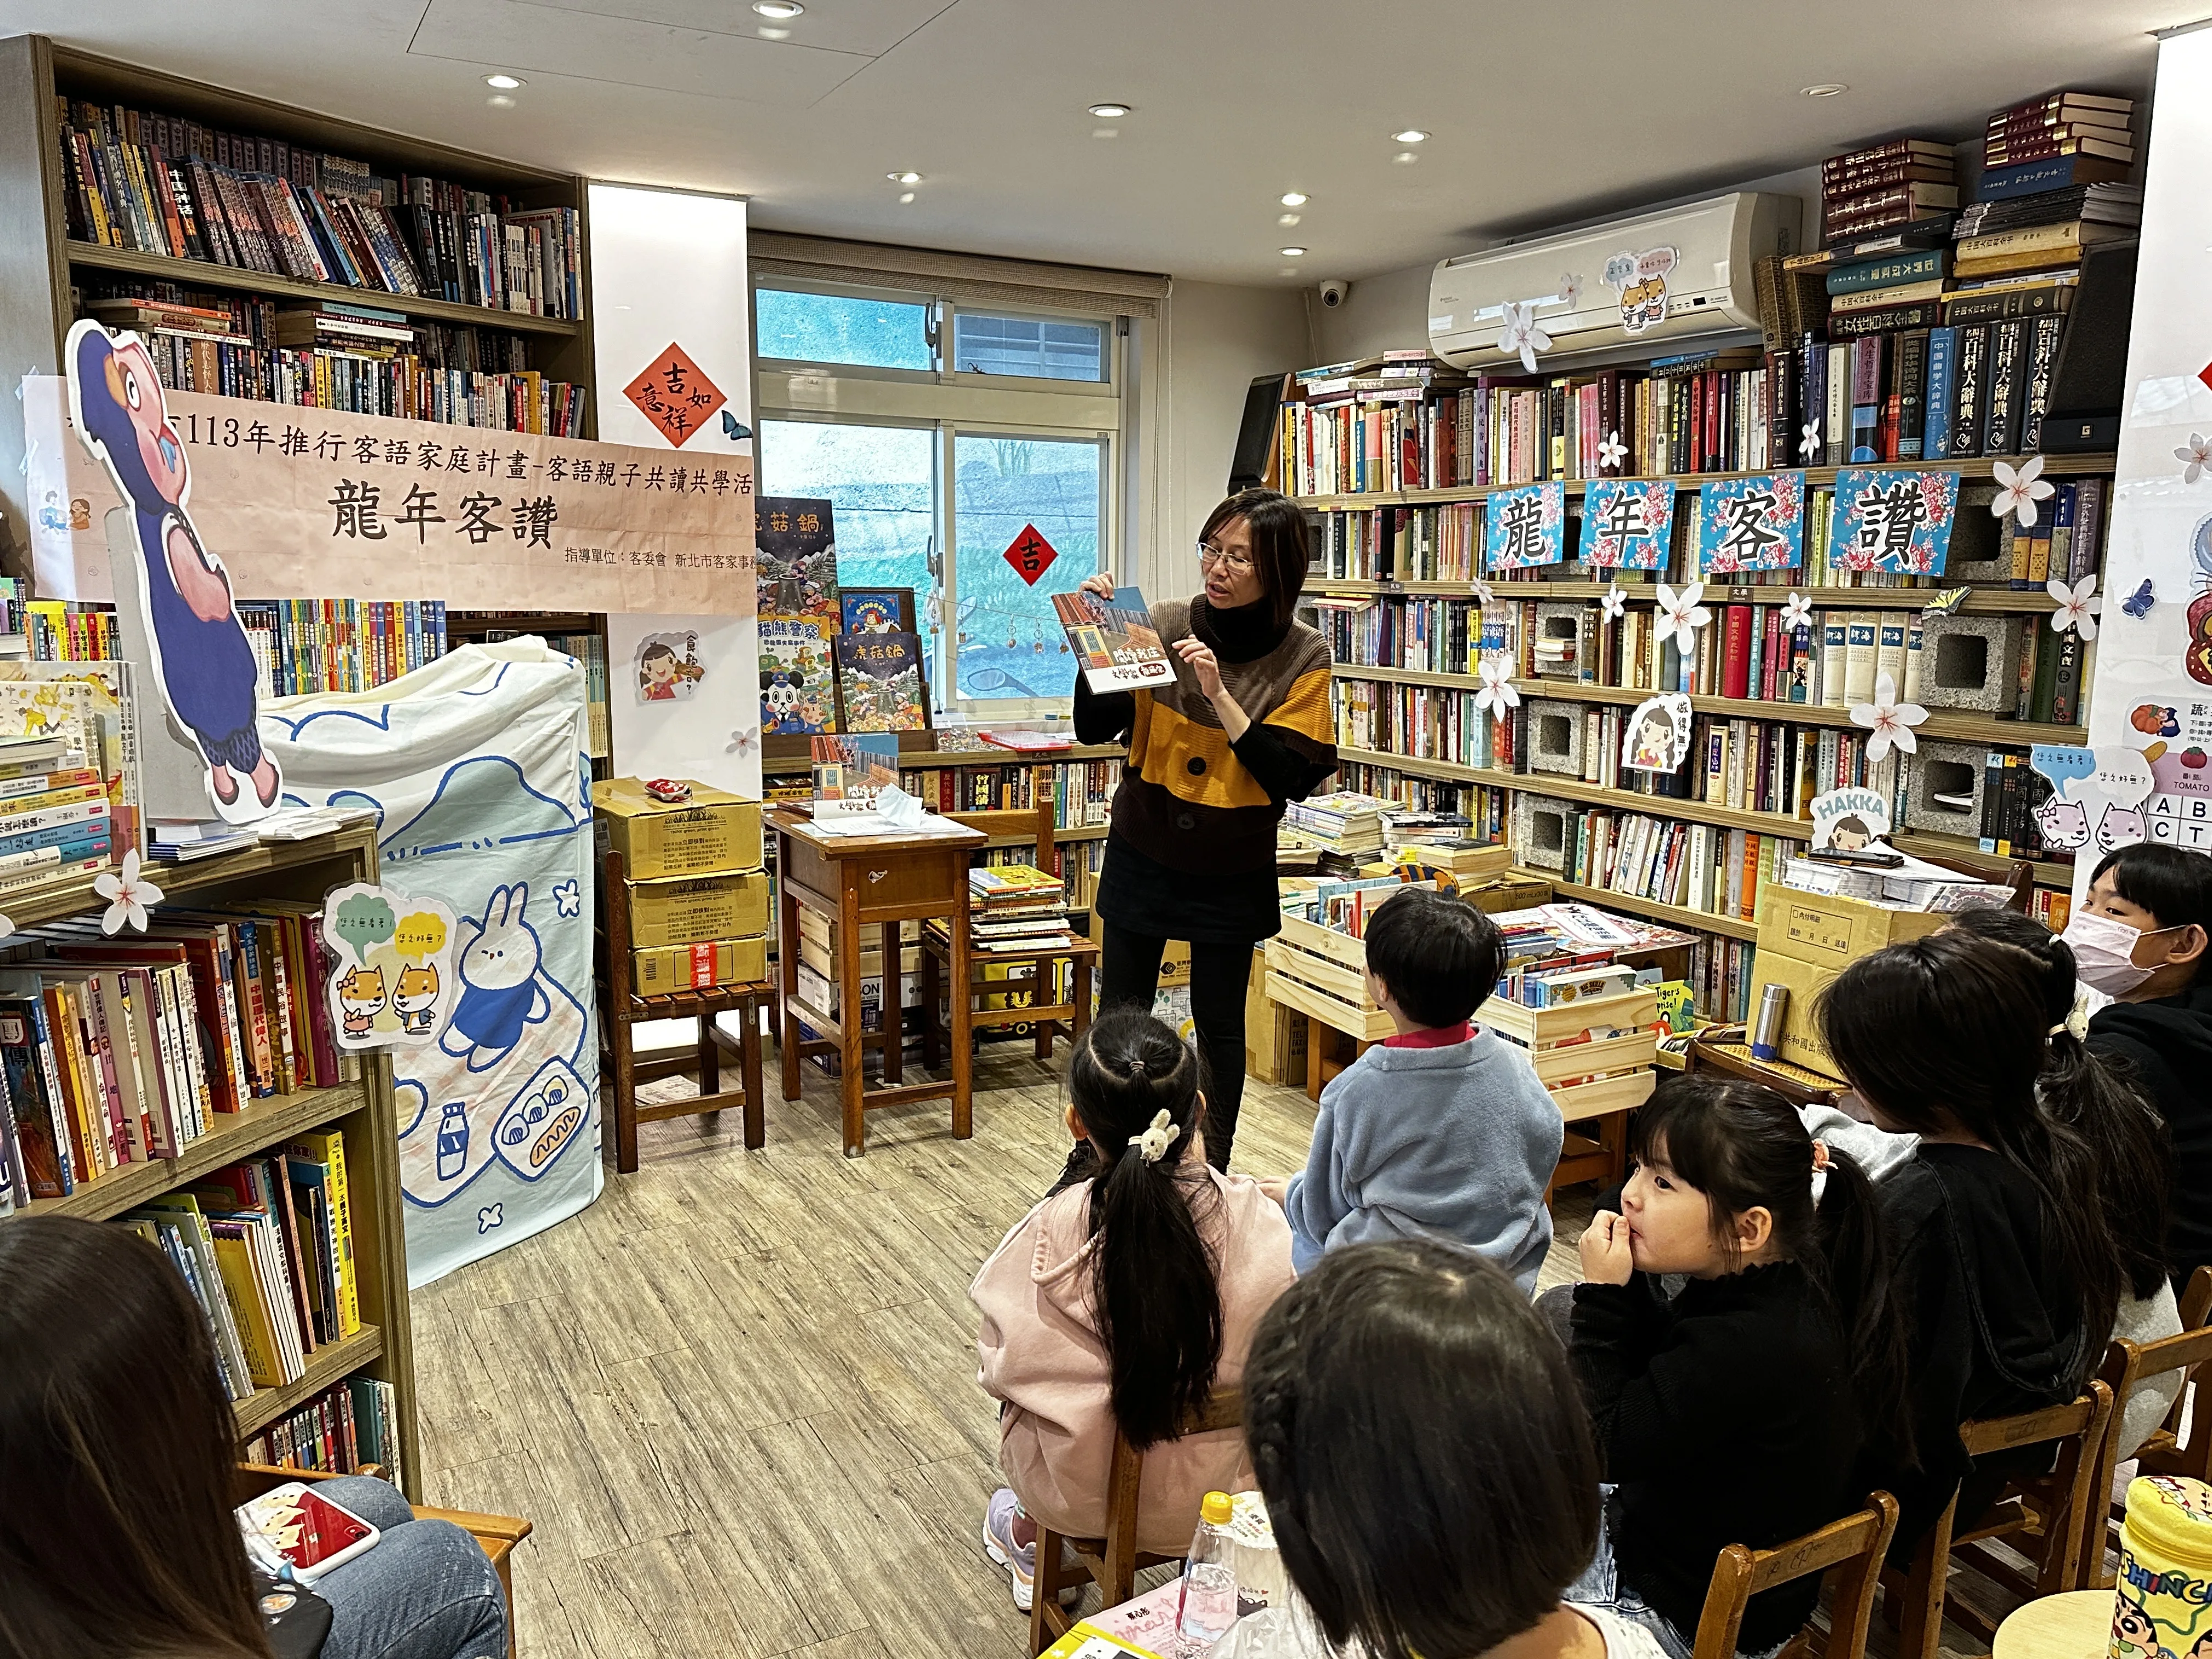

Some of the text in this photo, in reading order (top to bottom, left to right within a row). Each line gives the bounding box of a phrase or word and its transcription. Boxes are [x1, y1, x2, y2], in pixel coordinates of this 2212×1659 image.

[169, 169, 194, 216] 中國神話
[169, 414, 752, 495] 113年推行客語家庭計畫-客語親子共讀共學活
[327, 478, 558, 550] 龍年客讚
[1503, 482, 1927, 567] 龍 年 客 讚
[1019, 537, 1041, 572] 吉
[1111, 667, 1140, 680] 文學家
[2013, 770, 2028, 829] 中國神話
[2173, 781, 2210, 792] TOMATO
[1817, 793, 1884, 821] HAKKA
[2157, 798, 2207, 817] A B
[2155, 822, 2204, 843] C T
[1808, 933, 1815, 941] 月
[1822, 936, 1829, 944] 日
[274, 961, 289, 1038] 中國民俗故事
[860, 983, 880, 996] ON
[1655, 986, 1680, 1000] Tiger's
[94, 992, 108, 1033] 世界偉人傳記
[250, 984, 268, 1047] 中國歷代偉人
[8, 1046, 30, 1066] 傳
[2121, 1549, 2212, 1606] SHINC
